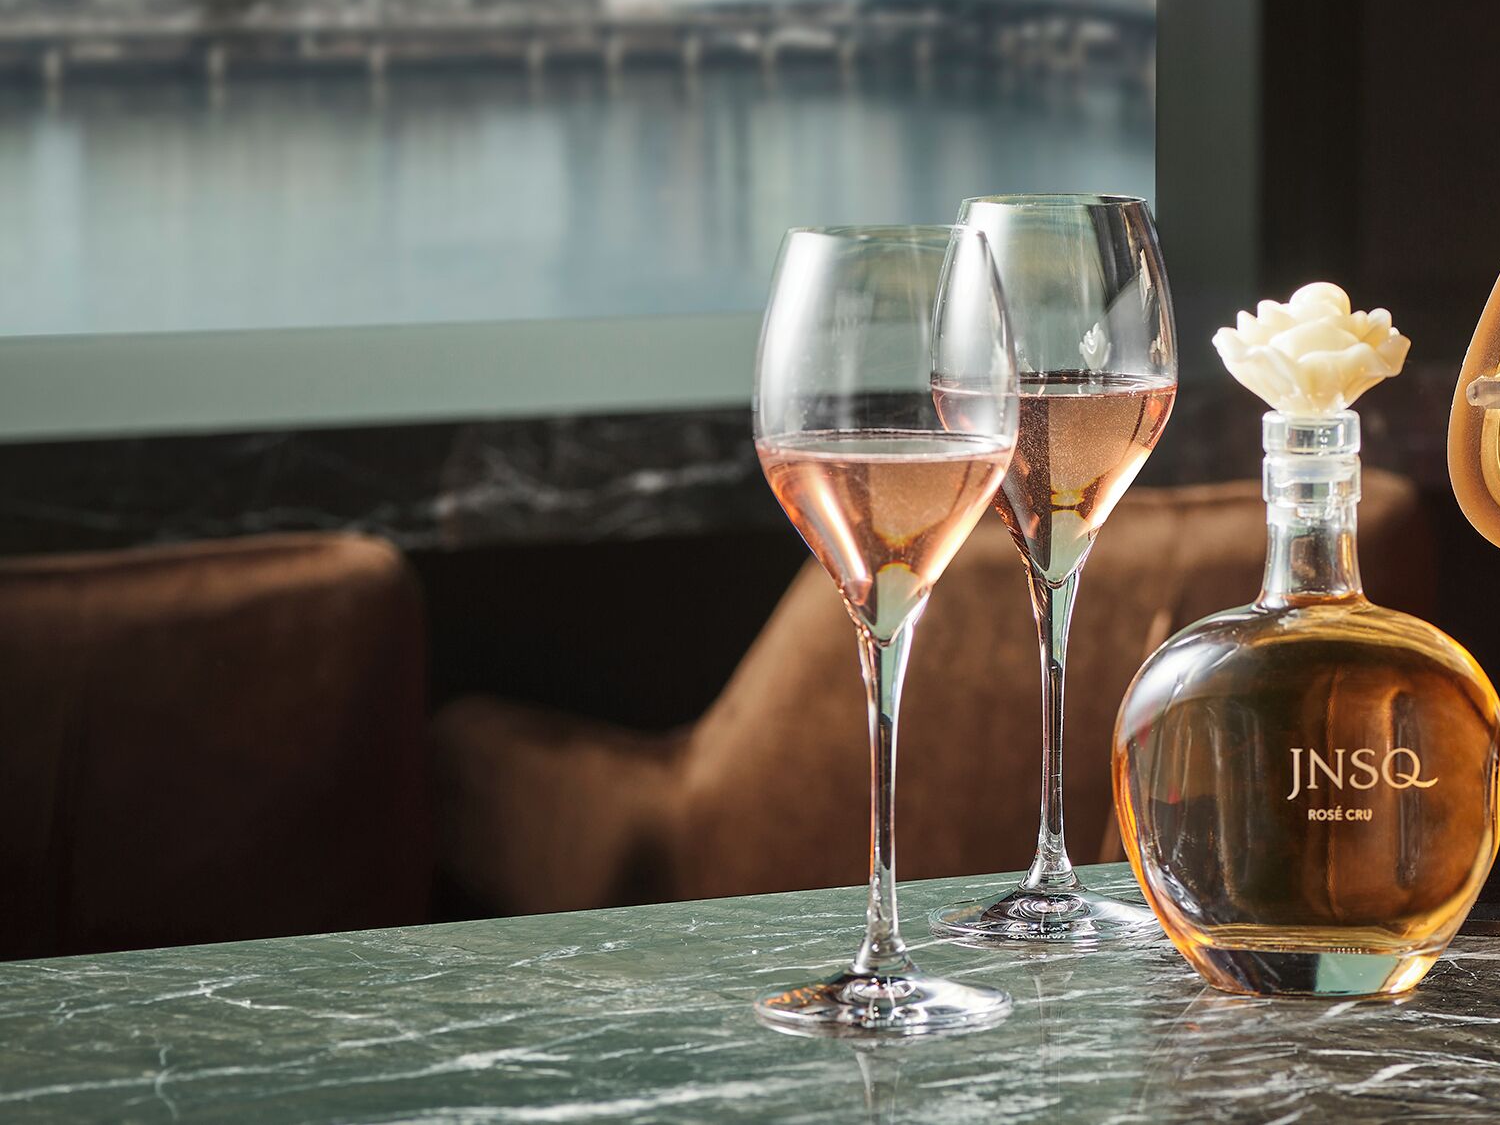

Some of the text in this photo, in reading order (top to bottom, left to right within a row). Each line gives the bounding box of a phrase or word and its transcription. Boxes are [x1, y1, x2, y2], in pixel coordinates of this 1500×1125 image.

[1286, 747, 1439, 801] JNSQ
[1308, 805, 1373, 822] ROSÉ CRU
